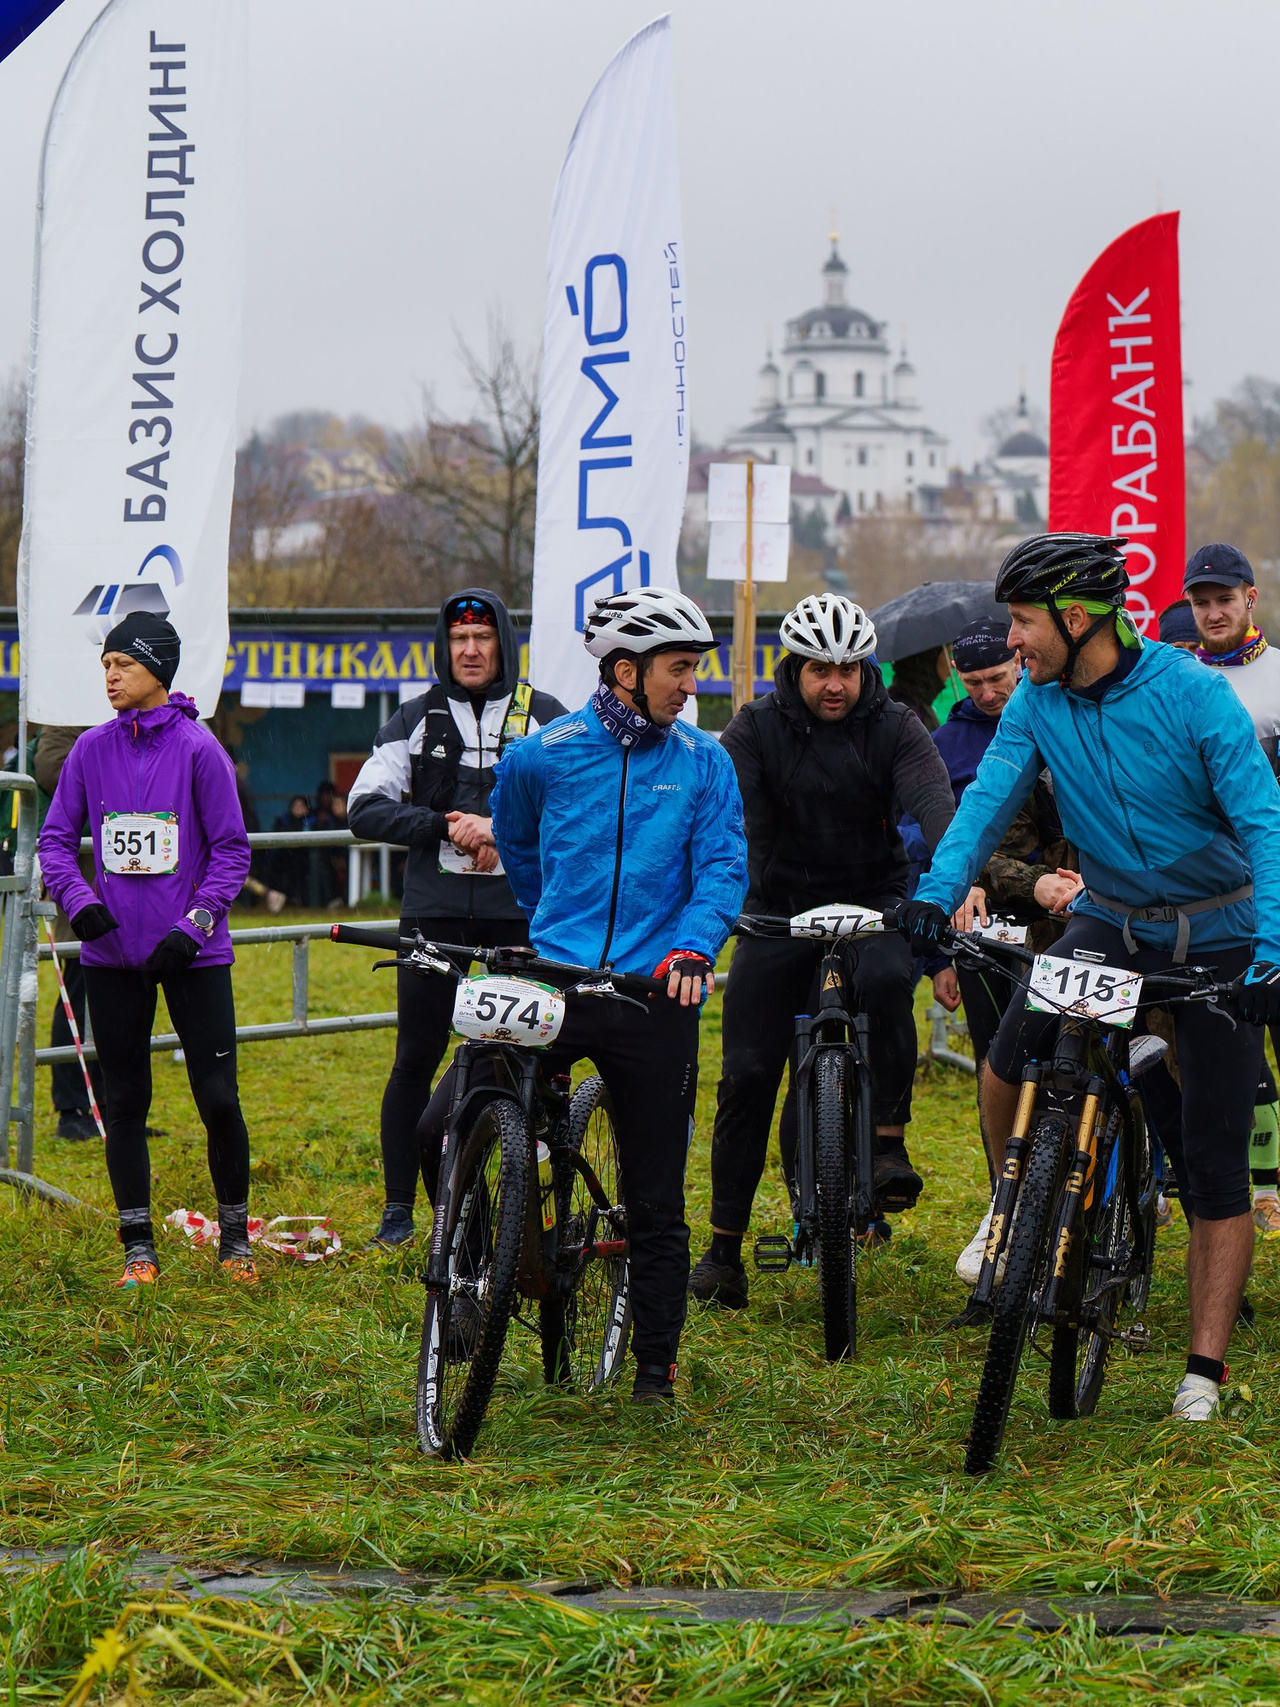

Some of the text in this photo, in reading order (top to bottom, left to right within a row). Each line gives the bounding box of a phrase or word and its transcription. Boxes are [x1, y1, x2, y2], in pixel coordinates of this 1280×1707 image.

[123, 30, 196, 522] БАЗИС ХОЛДИНГ
[1049, 571, 1078, 595] KELLYS
[132, 642, 163, 666] MARATHON
[135, 637, 153, 651] SPACE
[652, 784, 676, 792] CRAFT
[113, 830, 155, 856] 551
[810, 914, 864, 939] 577
[1054, 966, 1117, 1002] 115
[475, 991, 541, 1030] 574
[680, 1063, 691, 1096] KIPSTA
[430, 1203, 446, 1255] ROCKSHOX
[983, 1213, 1005, 1264] FOX
[1053, 1226, 1076, 1278] FOX
